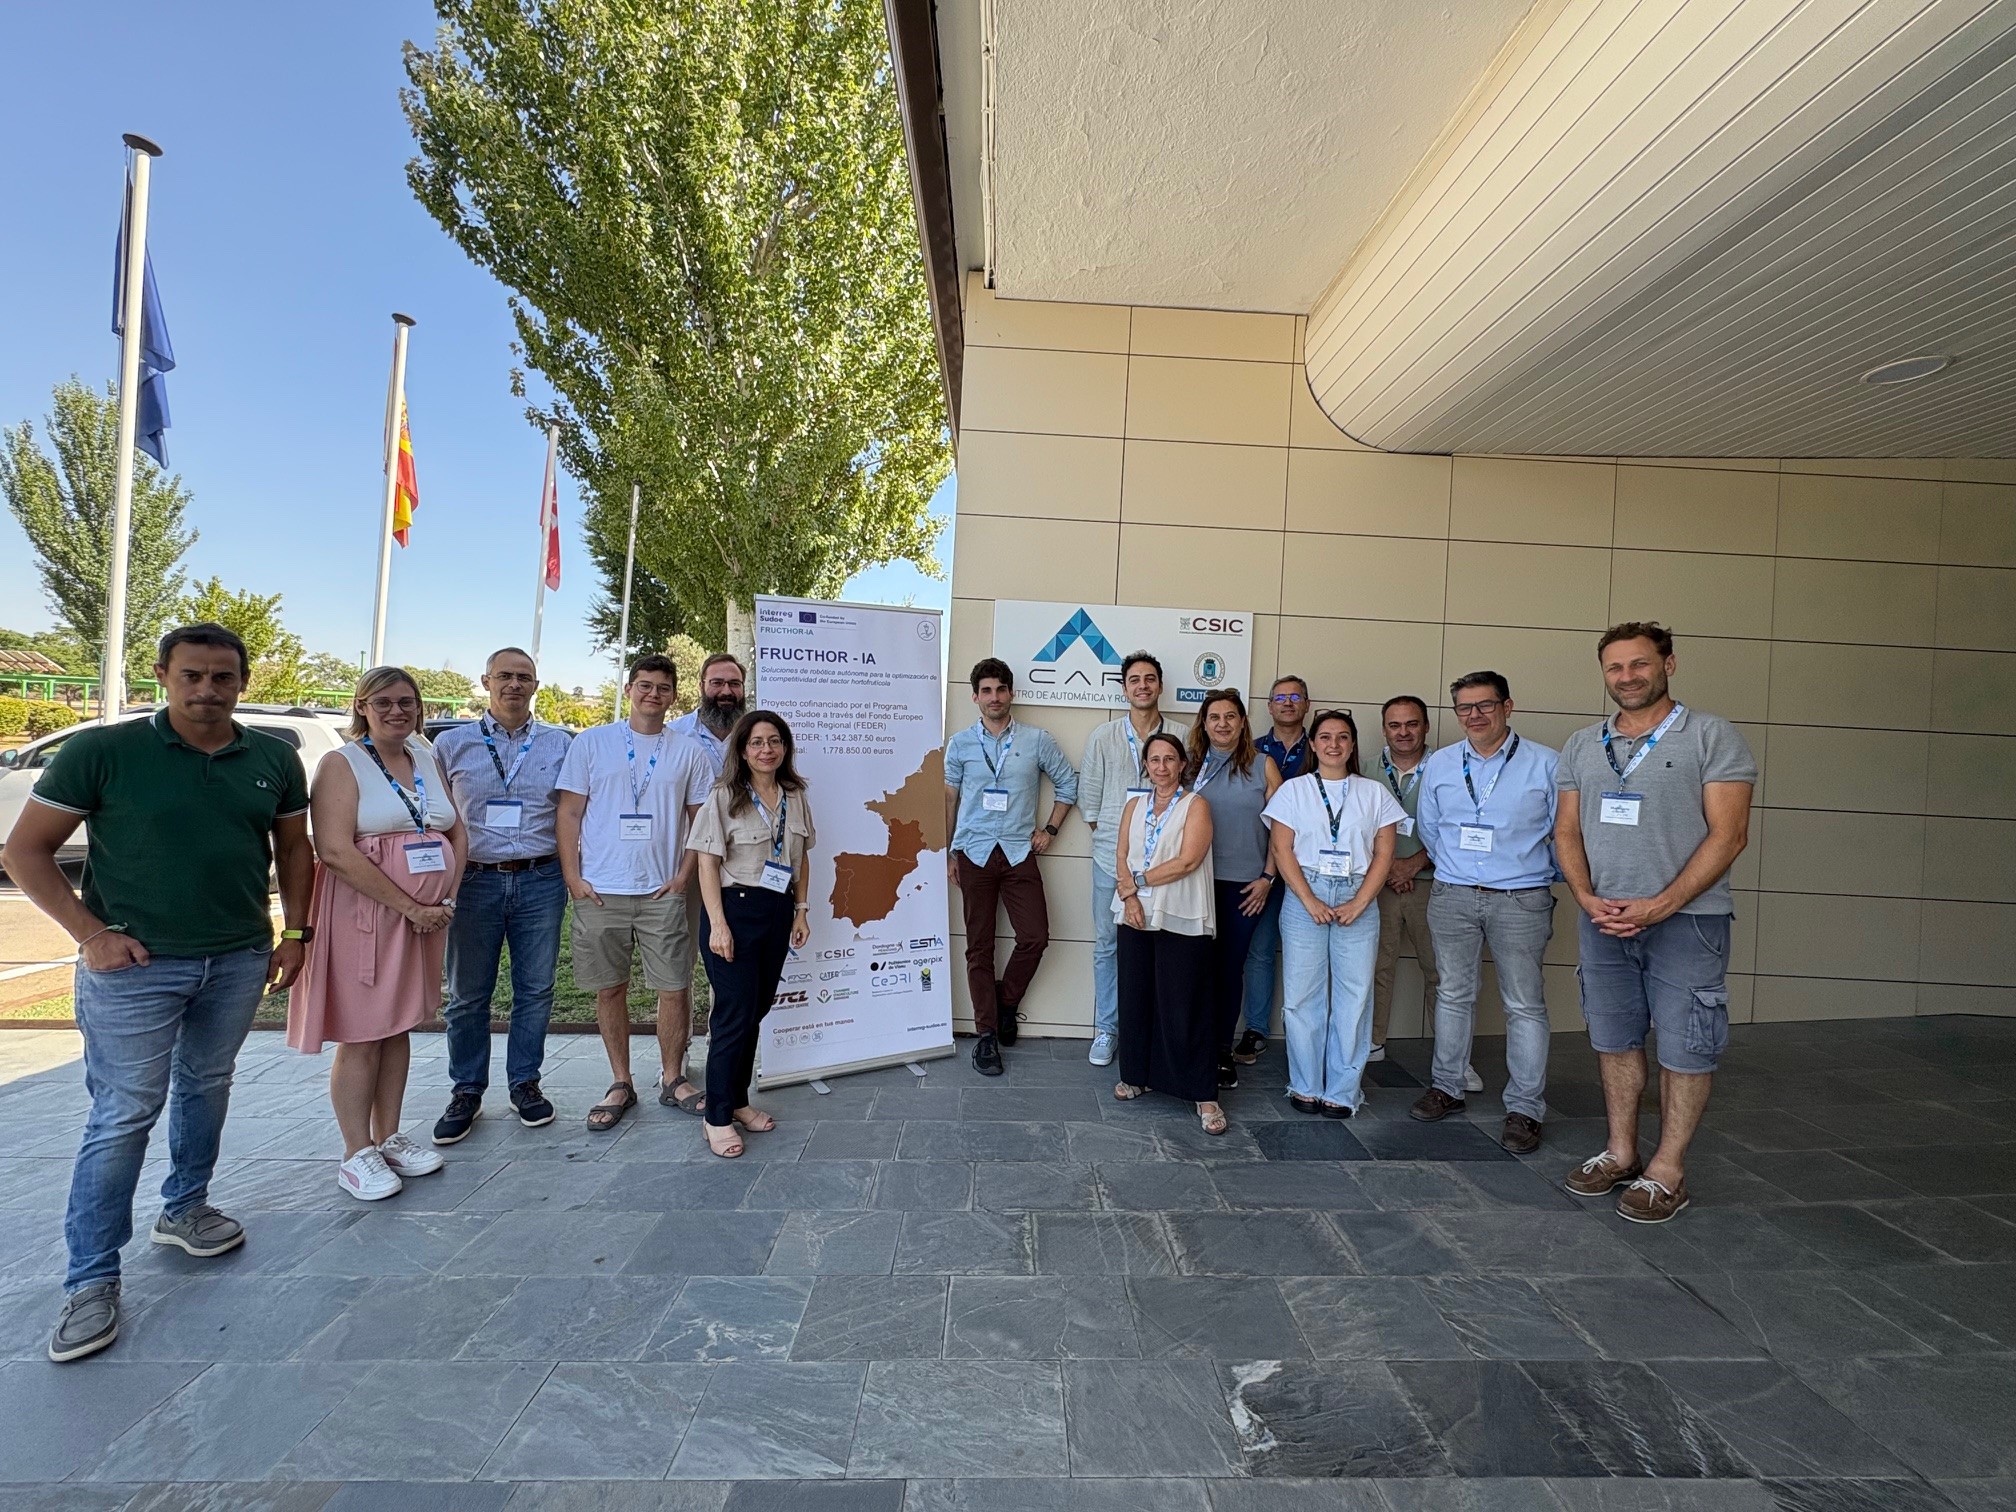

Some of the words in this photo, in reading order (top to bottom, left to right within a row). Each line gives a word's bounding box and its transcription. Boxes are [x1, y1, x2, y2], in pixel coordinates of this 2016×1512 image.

[760, 626, 814, 636] FRUCTHOR-IA
[1192, 617, 1244, 634] CSIC
[760, 647, 848, 664] FRUCTHOR
[861, 652, 877, 665] IA
[761, 666, 799, 674] Soluciones
[837, 670, 869, 678] autónoma
[892, 673, 929, 681] optimización
[769, 676, 817, 684] competitividad
[1036, 690, 1049, 700] DE
[1050, 691, 1106, 703] AUTOMÁTICA
[1107, 694, 1113, 702] Y
[761, 699, 798, 708] Proyecto
[799, 700, 848, 709] cofinanciado
[872, 703, 908, 711] Programa
[795, 710, 821, 718] Sudoe
[855, 712, 867, 720] del
[817, 721, 852, 730] Regional
[853, 722, 887, 731] (FEDER)
[909, 934, 944, 950] ESTIA
[824, 948, 855, 959] CSIC
[912, 955, 943, 967] agerpix
[773, 1026, 801, 1035] Cooperar
